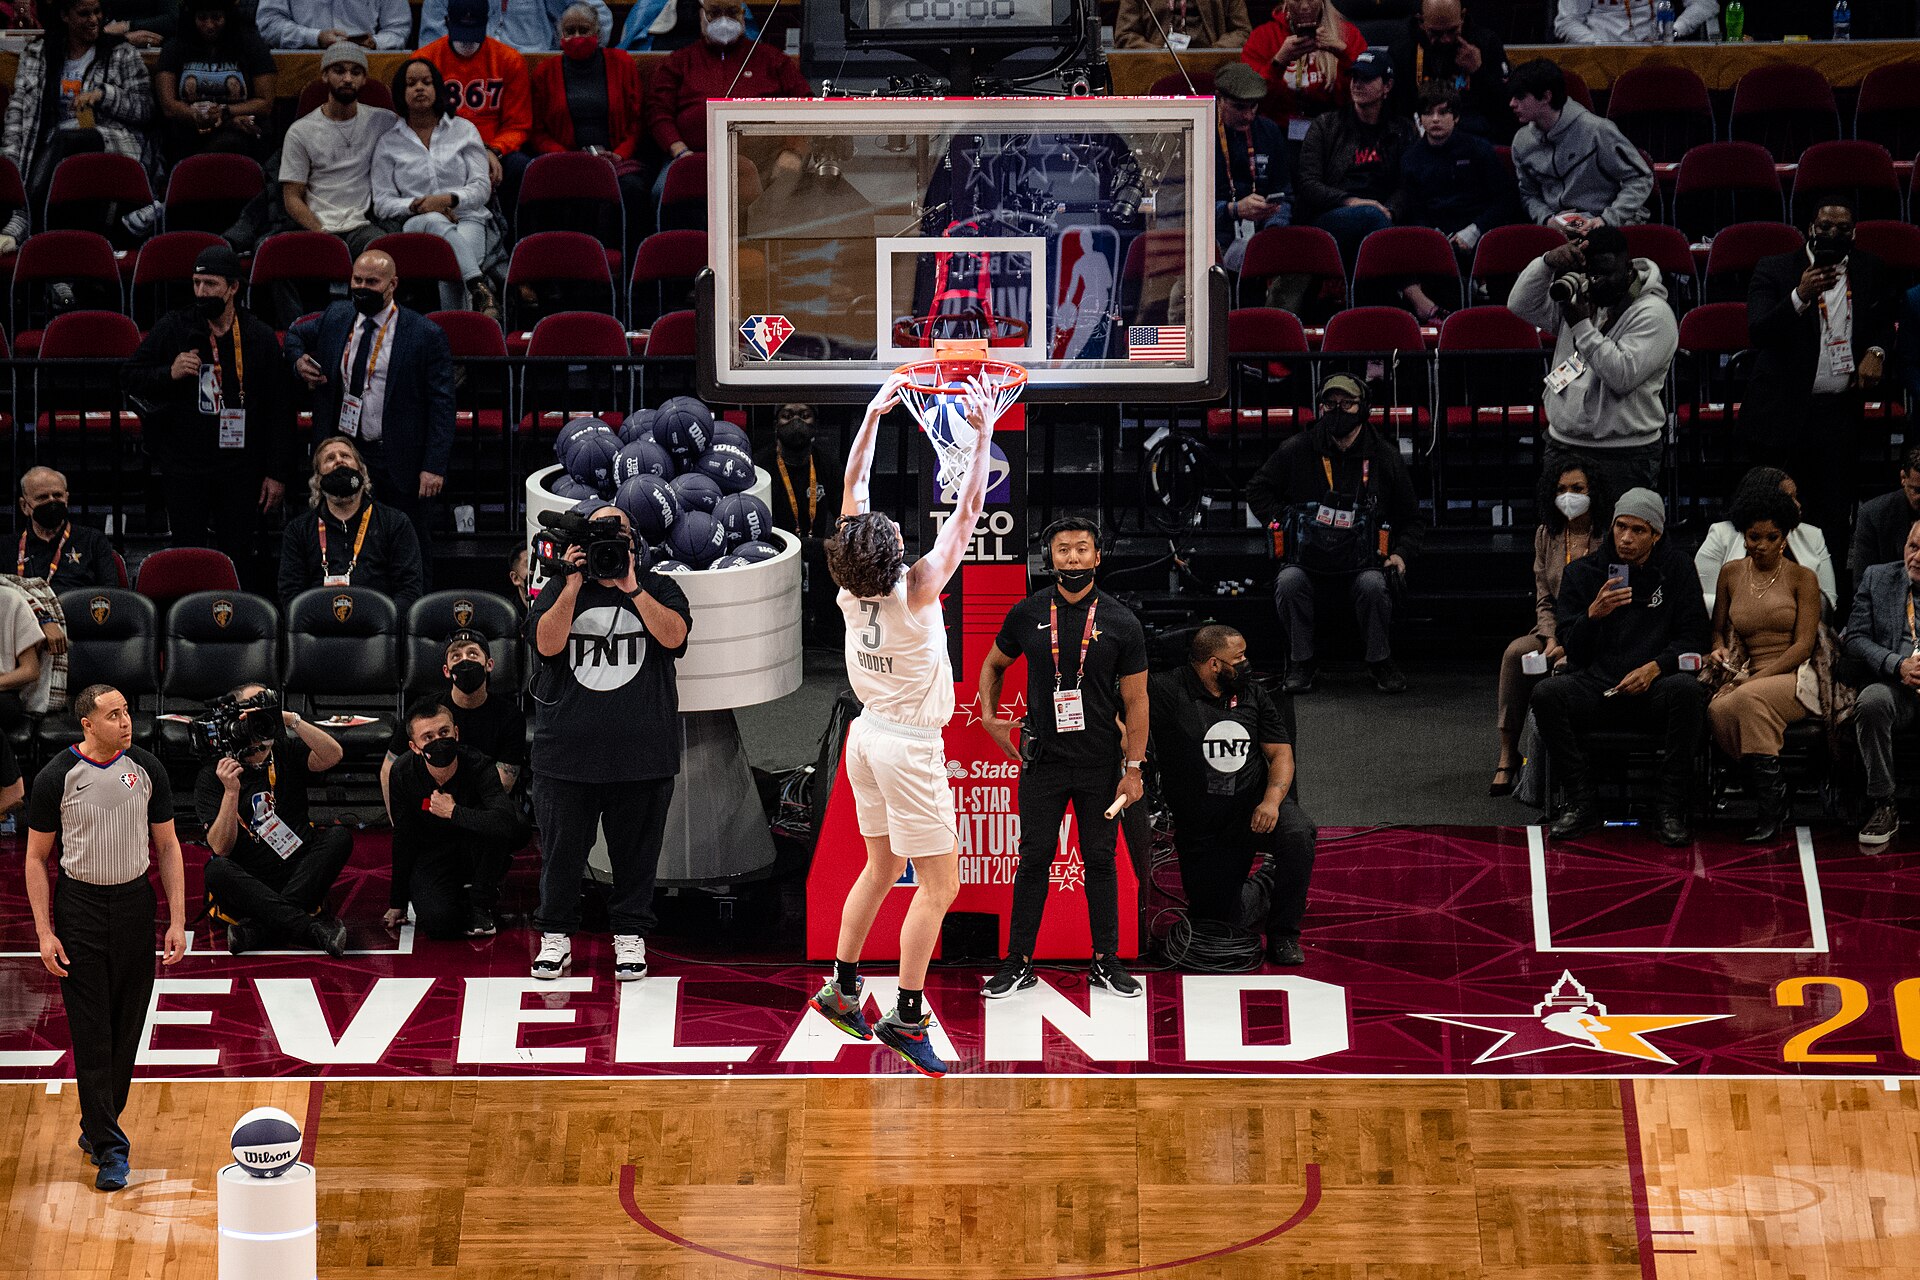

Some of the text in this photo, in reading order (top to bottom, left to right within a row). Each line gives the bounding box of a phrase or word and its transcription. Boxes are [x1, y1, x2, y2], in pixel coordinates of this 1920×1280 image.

[772, 322, 782, 336] 75
[689, 421, 707, 453] Wils
[713, 443, 752, 466] Wilson
[653, 488, 674, 528] Wilson
[461, 517, 474, 529] 10
[746, 509, 763, 541] Wils
[929, 510, 1015, 536] TCO
[963, 536, 1013, 561] ELL
[858, 599, 883, 651] 3
[569, 631, 646, 667] TNT
[857, 650, 893, 674] GIDDEY
[970, 760, 1019, 779] State
[971, 786, 1011, 813] STAR
[958, 813, 1073, 855] ATURY
[959, 856, 1020, 884] GHT 202
[0, 977, 1349, 1066] EVELAND
[244, 1149, 291, 1164] Wilson
